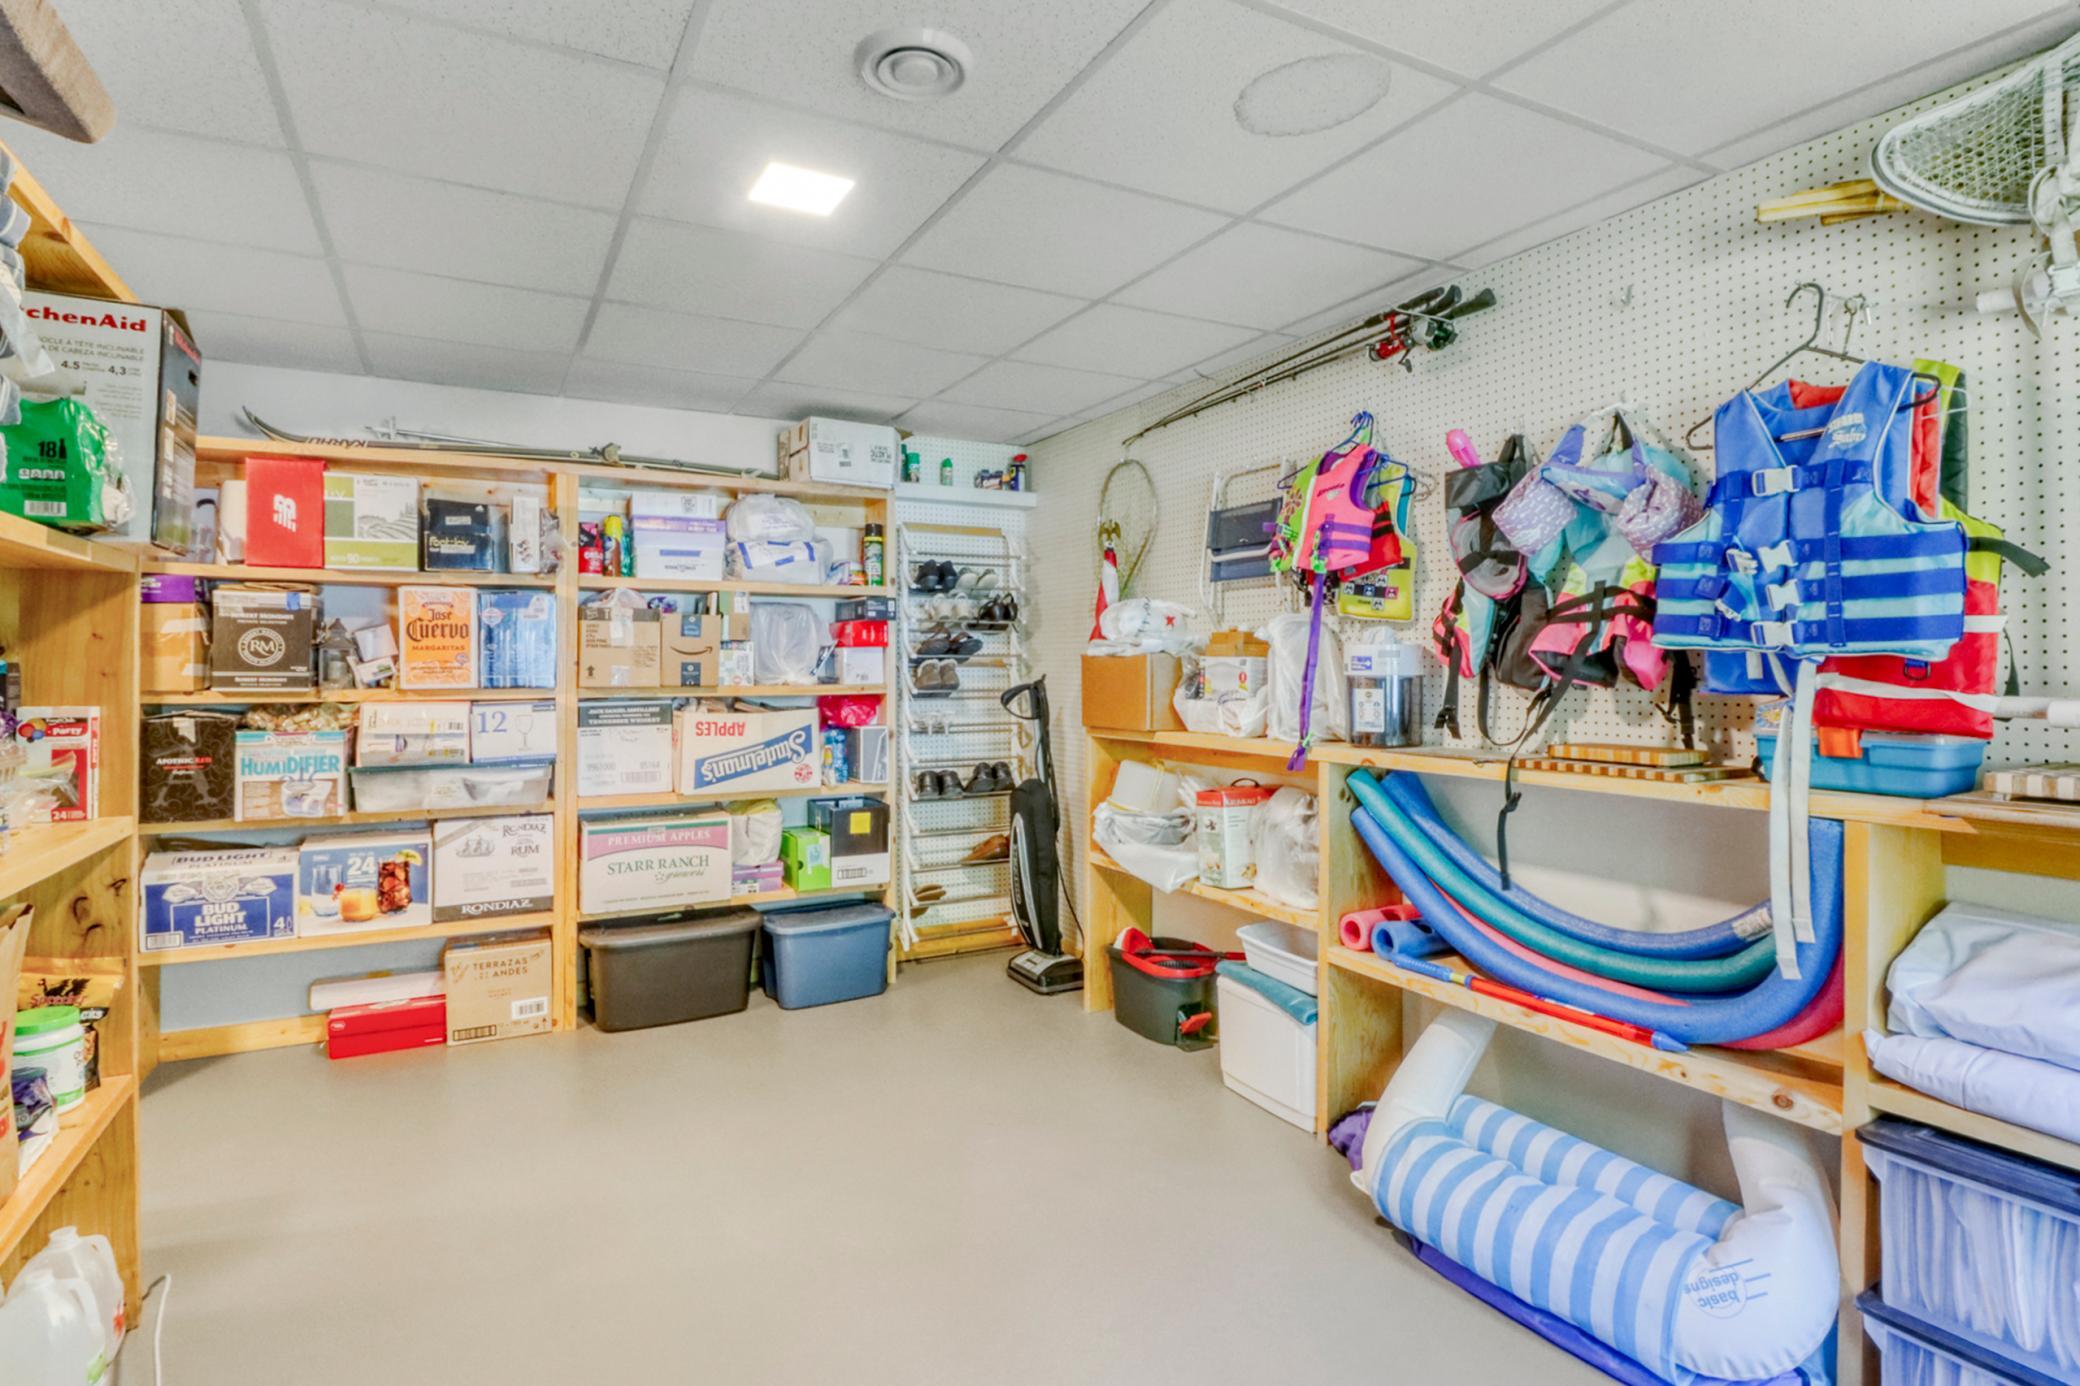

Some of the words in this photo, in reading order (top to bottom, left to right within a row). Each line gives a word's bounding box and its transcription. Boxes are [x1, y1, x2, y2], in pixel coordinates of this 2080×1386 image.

[21, 306, 147, 332] chenAid
[60, 360, 80, 370] 4.5
[38, 441, 57, 459] 18
[405, 617, 470, 642] Cuervo
[249, 639, 277, 657] RM
[478, 710, 508, 734] 12
[695, 721, 746, 736] APPLES
[701, 730, 807, 783] Stadelman's
[503, 823, 546, 837] RONDIAZ
[608, 832, 666, 847] PREMIUM
[670, 829, 712, 842] APPLES
[216, 852, 268, 862] LIGHT
[511, 845, 540, 857] RUM
[347, 856, 375, 876] 24
[607, 859, 655, 876] STARR
[658, 854, 710, 870] RANCH
[202, 902, 240, 916] BUD
[461, 898, 534, 916] RONDIAZ
[194, 911, 247, 927] LIGHT
[273, 916, 286, 930] 4
[194, 924, 248, 935] PLATINUM
[473, 957, 529, 970] TERRAZAS
[492, 966, 529, 977] ANDES
[1683, 1272, 1740, 1294] designs
[1698, 1290, 1741, 1309] basic
